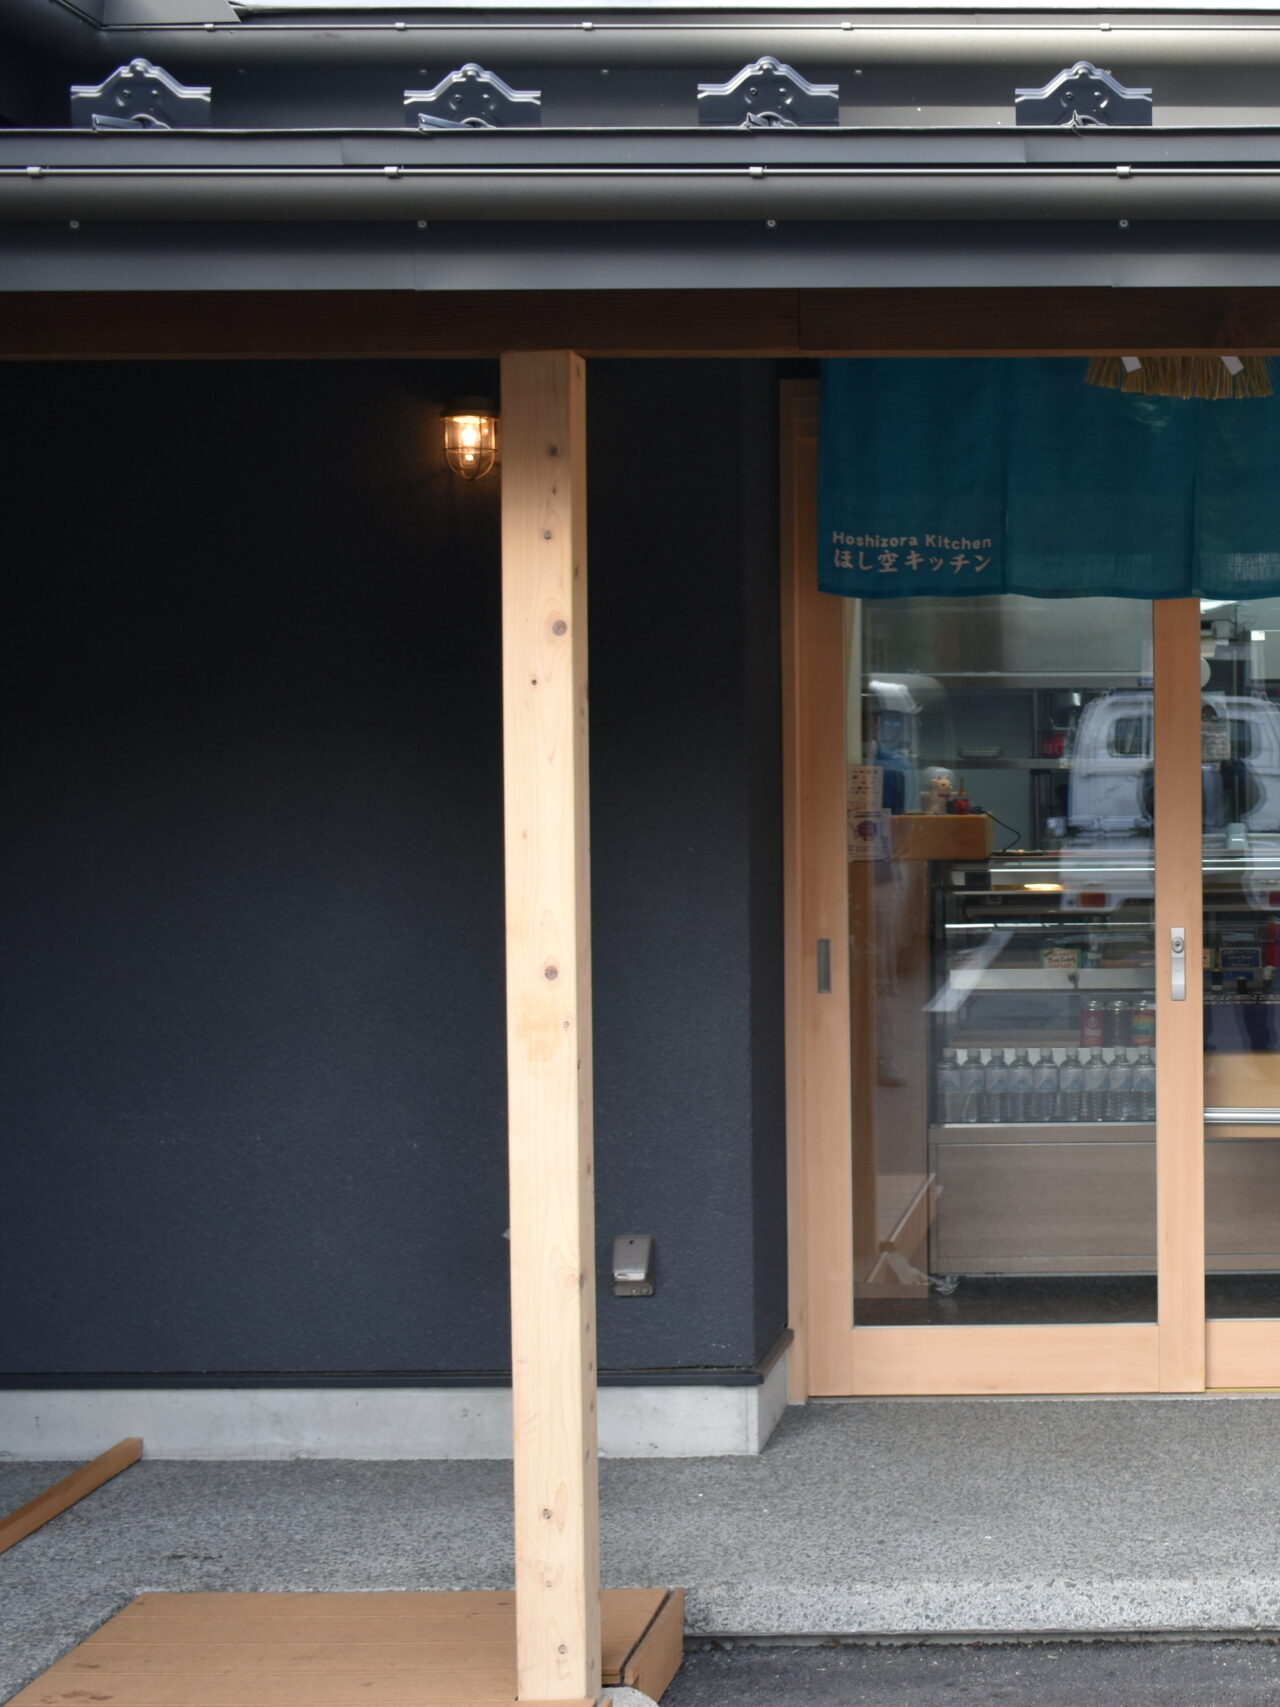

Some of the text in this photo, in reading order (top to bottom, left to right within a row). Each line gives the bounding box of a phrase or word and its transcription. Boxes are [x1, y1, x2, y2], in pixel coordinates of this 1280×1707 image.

[832, 531, 992, 550] Hoshizora Kitchen
[834, 549, 992, 574] ほし空キッチン
